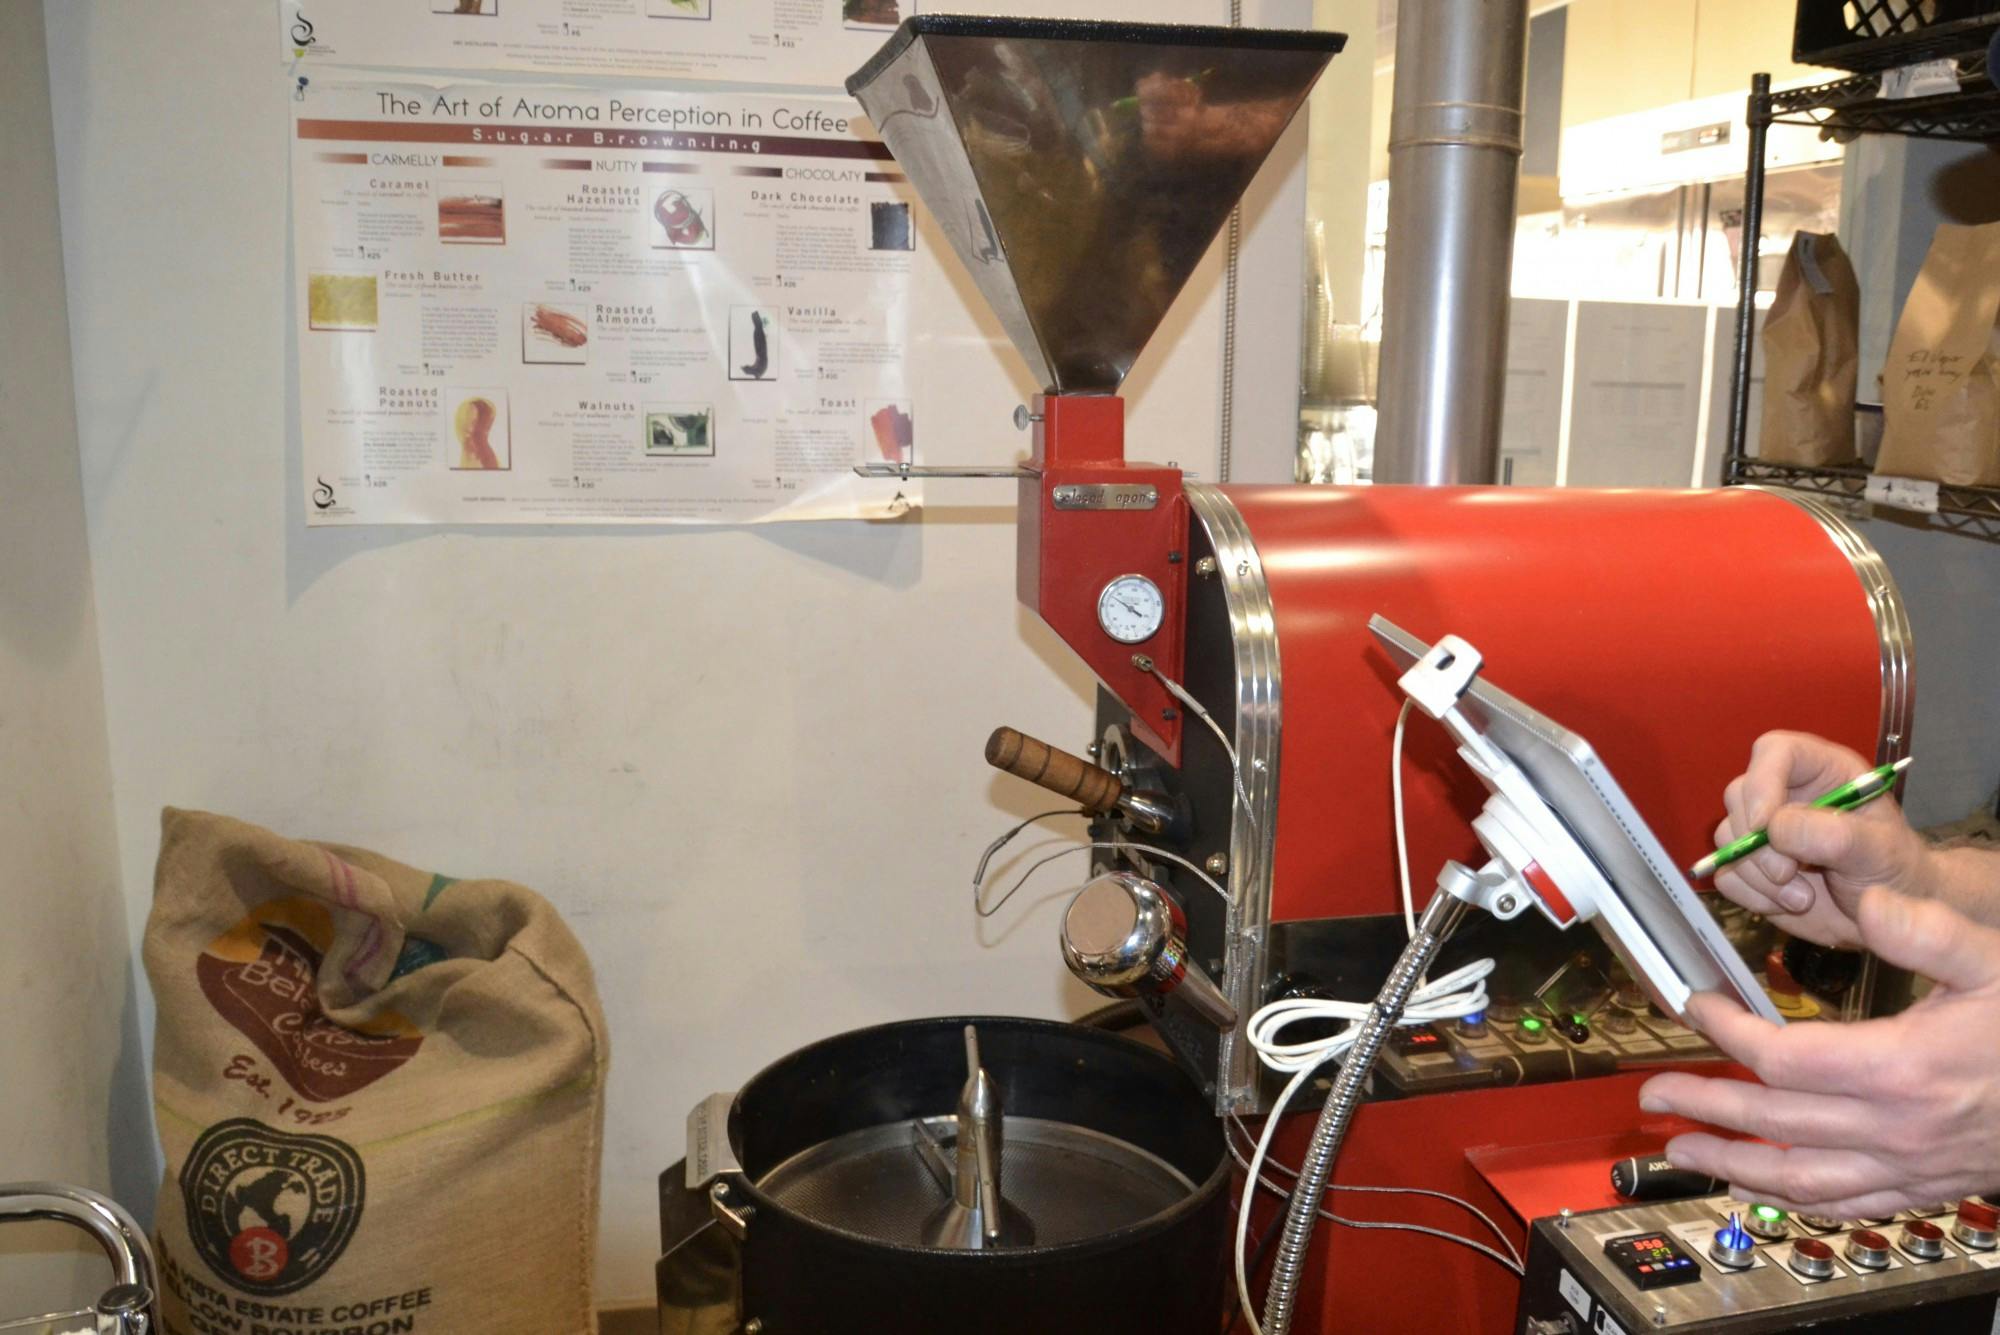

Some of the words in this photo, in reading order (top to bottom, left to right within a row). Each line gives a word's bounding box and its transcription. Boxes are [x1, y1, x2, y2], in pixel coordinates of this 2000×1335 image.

[376, 92, 421, 115] The
[432, 95, 469, 117] Art
[479, 96, 502, 117] of
[513, 98, 599, 120] Aroma
[609, 100, 731, 129] Perception
[742, 108, 762, 128] in
[772, 108, 848, 133] Coffee
[371, 153, 438, 167] CARMELLY
[596, 160, 638, 173] NUTTY
[785, 167, 862, 182] CHOCOLATY
[369, 179, 430, 189] Caramel
[582, 184, 640, 195] Roasted
[567, 195, 640, 206] Hazelnuts
[751, 190, 782, 202] Dark
[791, 192, 860, 204] Chocolate
[384, 271, 424, 281] Fresh
[434, 271, 480, 281] Butter
[596, 304, 654, 315] Roasted
[787, 306, 836, 317] Vanilla
[596, 315, 657, 325] Almonds
[379, 387, 438, 397] Roasted
[379, 398, 438, 408] Peanuts
[579, 401, 635, 411] Walnuts
[820, 398, 857, 408] Toast
[1116, 493, 1147, 508] open
[223, 1054, 271, 1098] Est.
[202, 1146, 279, 1214] DIRECT
[288, 1151, 337, 1224] TRADE
[234, 1298, 324, 1324] ESTATE
[331, 1287, 433, 1323] COFFEE
